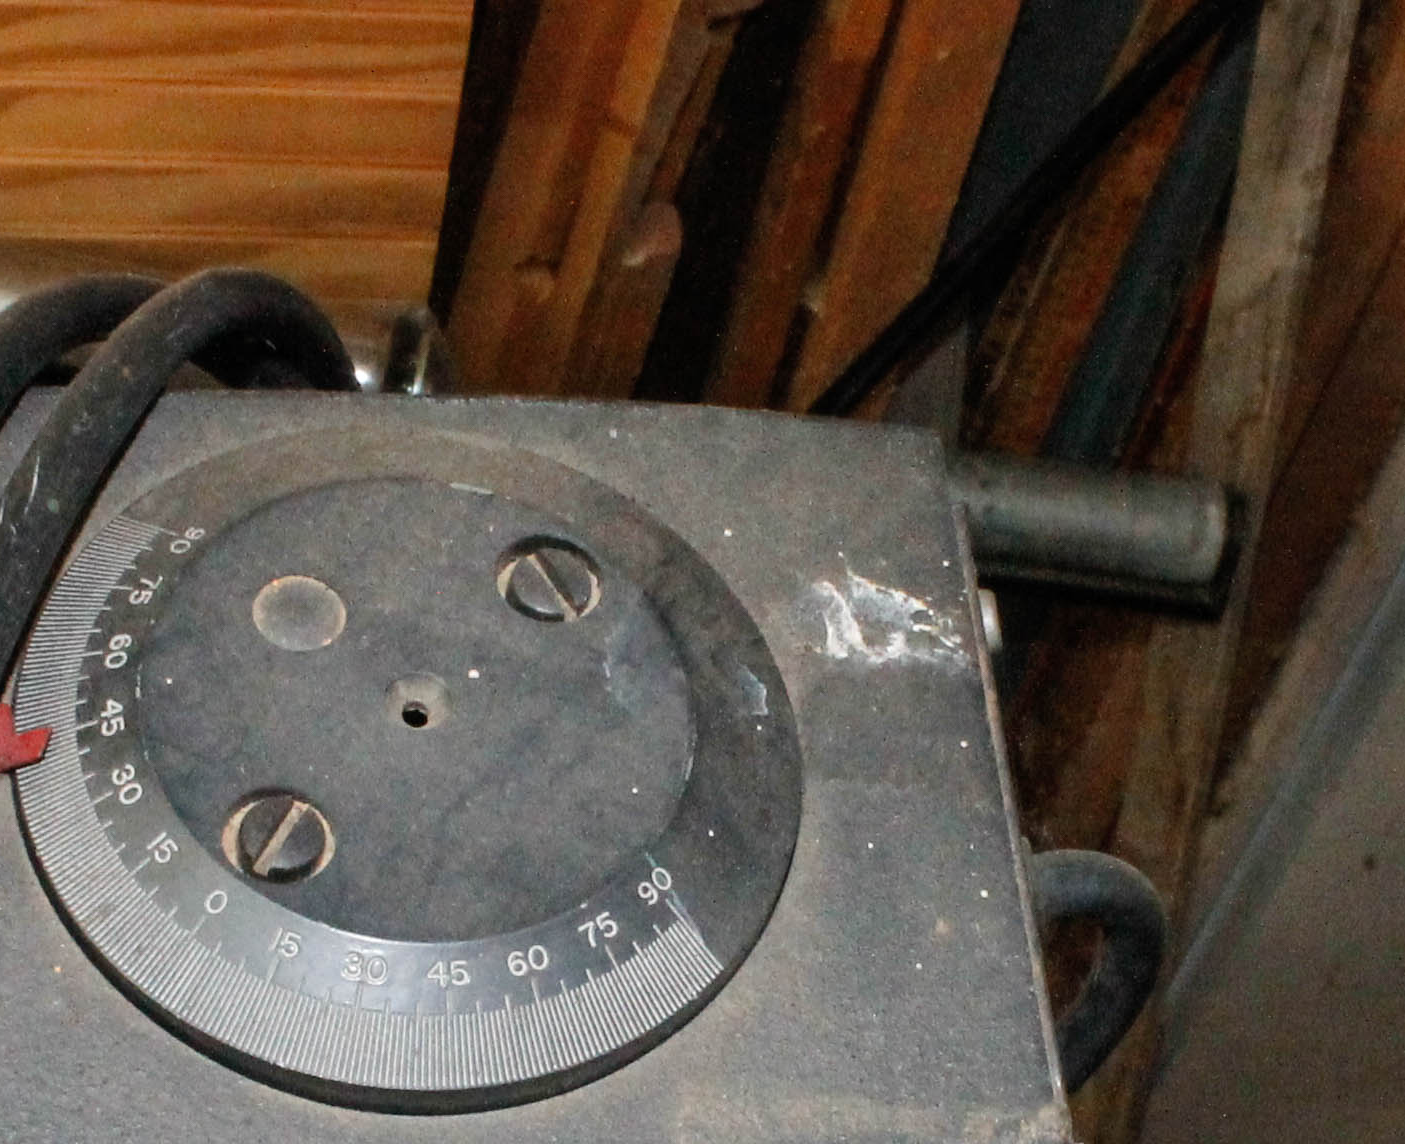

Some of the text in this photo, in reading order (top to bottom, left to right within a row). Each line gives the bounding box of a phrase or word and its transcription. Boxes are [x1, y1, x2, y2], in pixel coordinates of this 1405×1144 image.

[169, 527, 205, 554] 90
[129, 575, 164, 605] 75
[104, 633, 132, 669] 60
[100, 699, 125, 737] 45
[112, 764, 143, 805] 30
[147, 832, 179, 863] 15
[204, 890, 228, 914] 0
[637, 867, 672, 906] 90
[270, 927, 301, 958] 15
[577, 911, 618, 948] 75
[340, 951, 388, 985] 30
[427, 960, 470, 988] 45
[507, 945, 549, 976] 60
